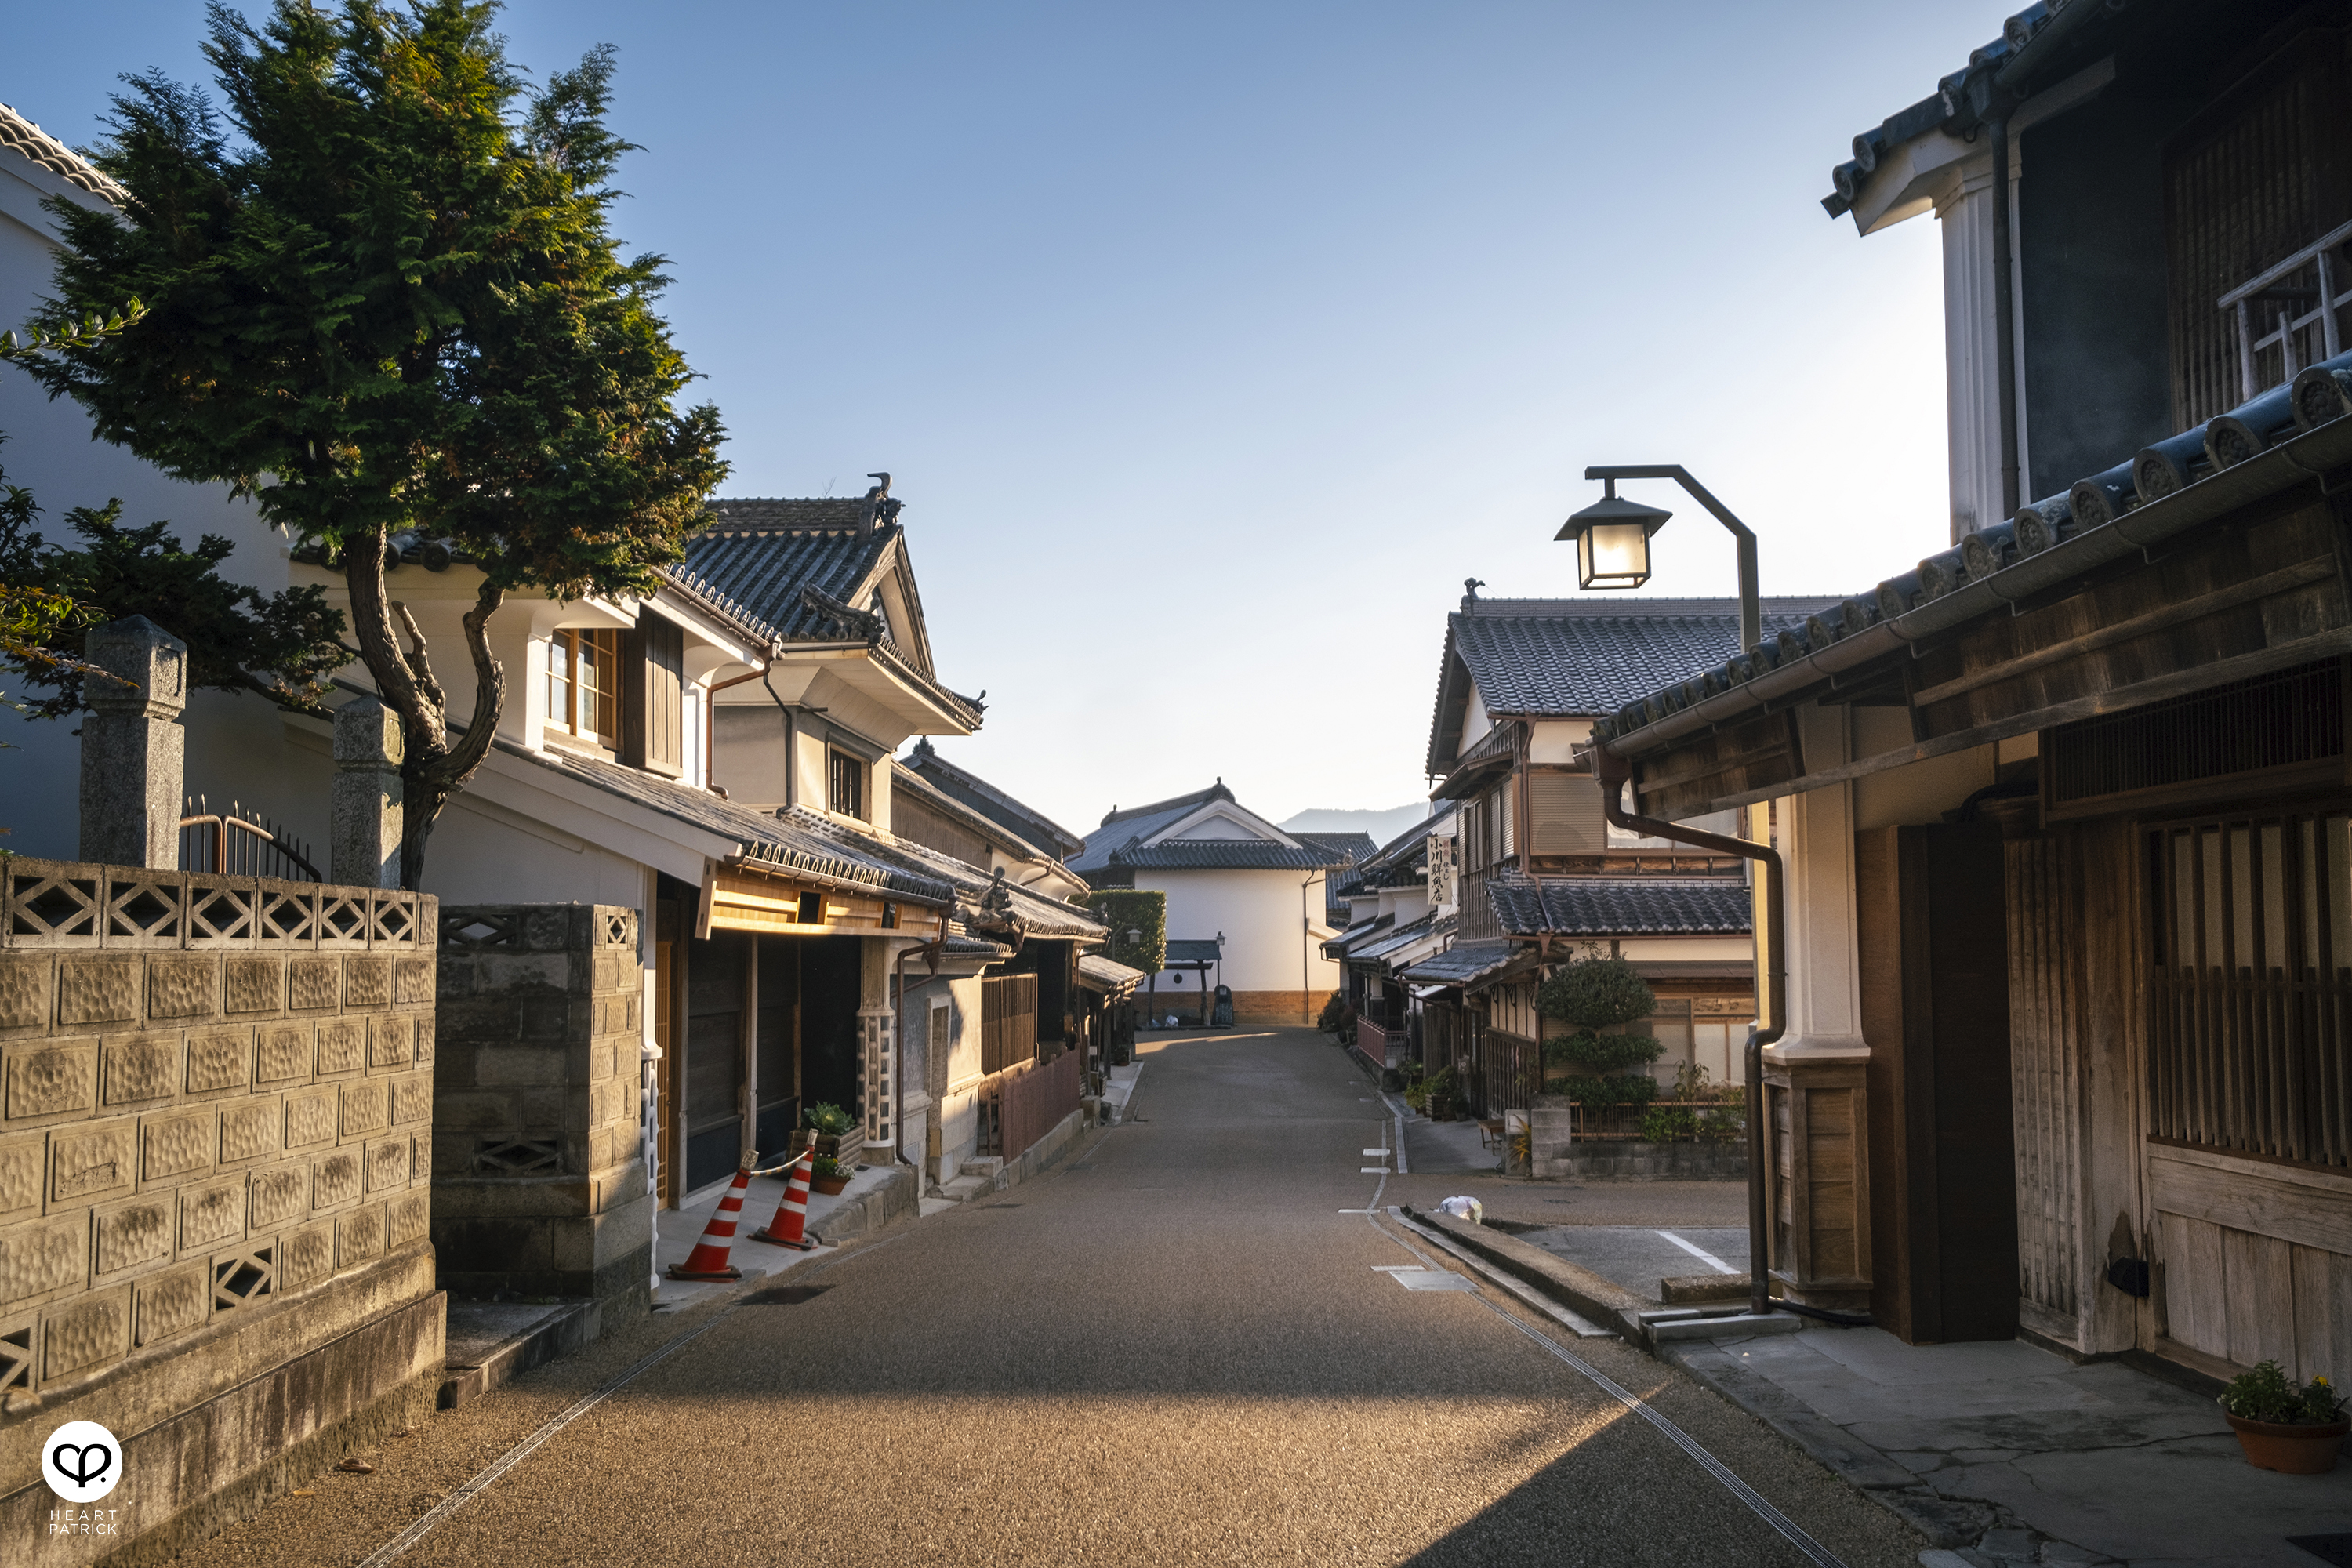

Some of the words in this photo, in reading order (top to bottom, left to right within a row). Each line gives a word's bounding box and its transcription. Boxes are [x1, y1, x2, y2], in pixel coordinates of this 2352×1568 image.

[1430, 837, 1443, 902] 小川鮮魚店
